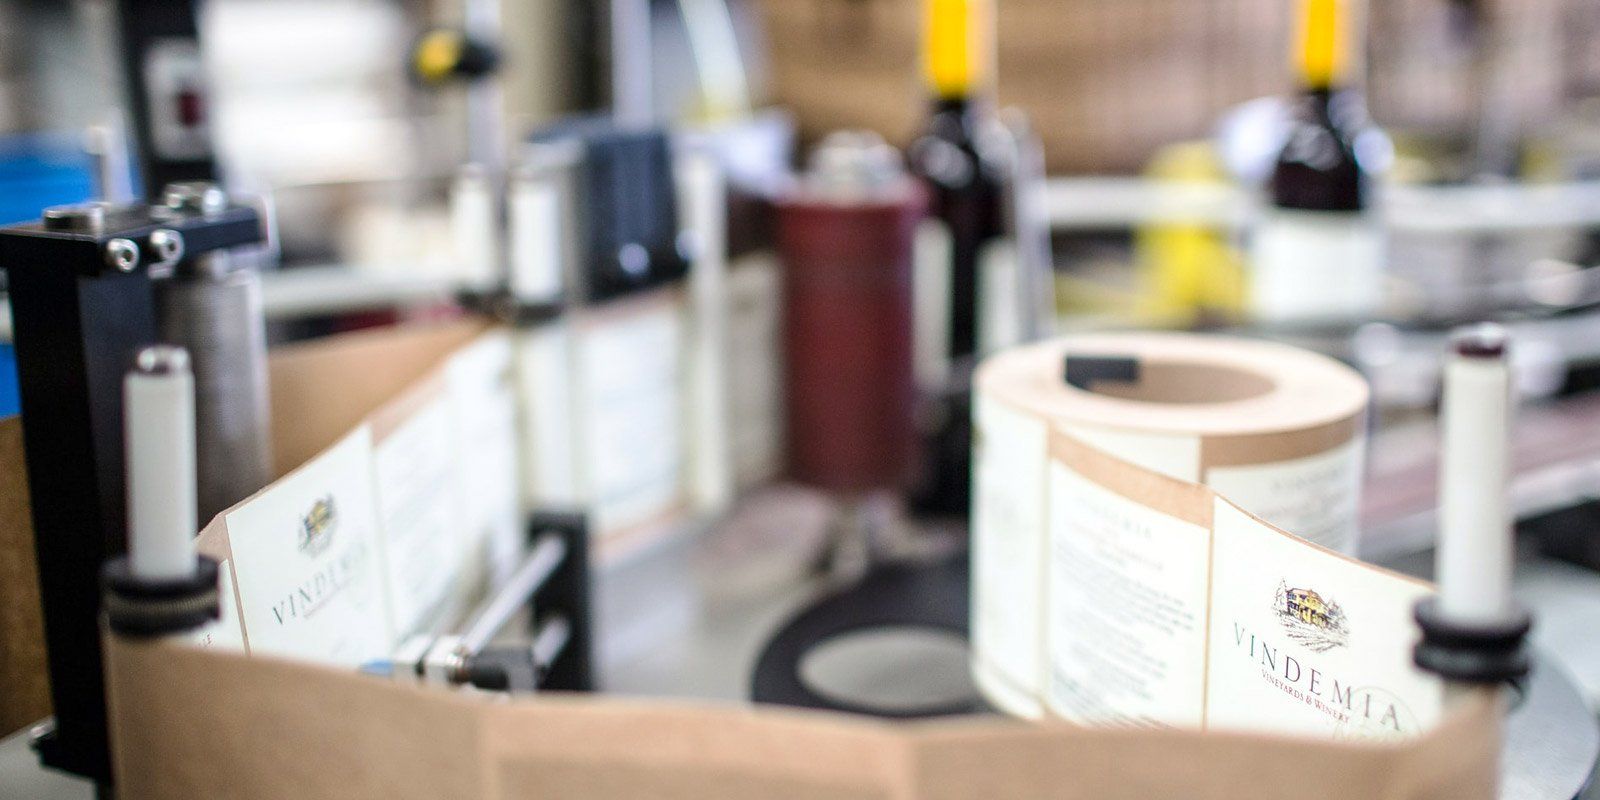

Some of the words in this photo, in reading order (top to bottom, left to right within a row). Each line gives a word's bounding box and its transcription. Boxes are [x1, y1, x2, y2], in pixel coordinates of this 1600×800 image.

[1234, 622, 1401, 731] VINDEMIA
[1261, 668, 1304, 702] VINEYARDS
[1305, 695, 1313, 705] &
[1314, 698, 1350, 724] WINERY
